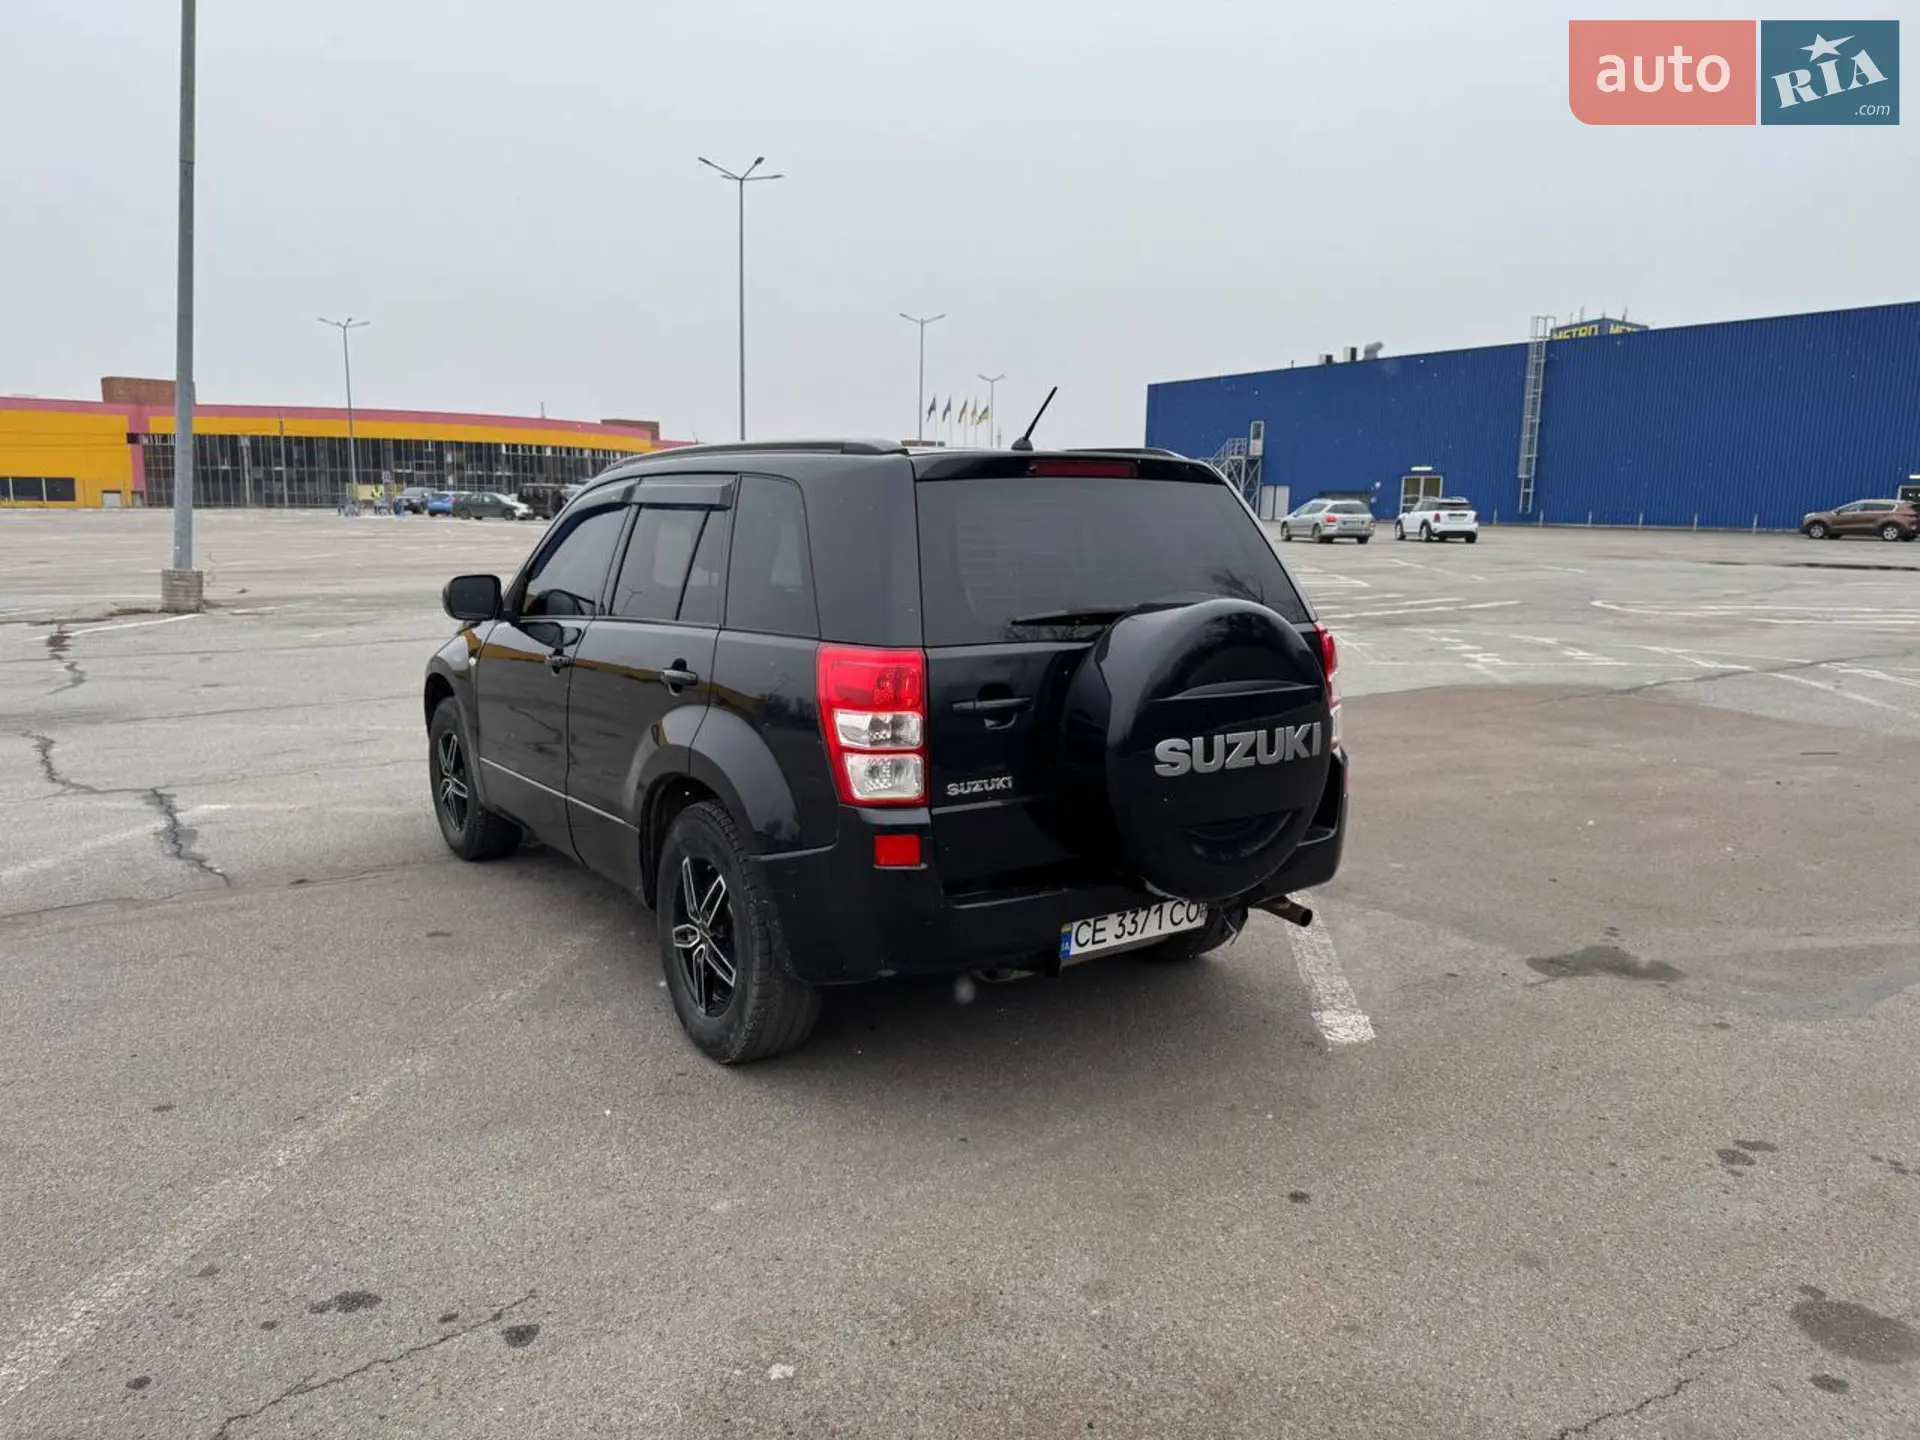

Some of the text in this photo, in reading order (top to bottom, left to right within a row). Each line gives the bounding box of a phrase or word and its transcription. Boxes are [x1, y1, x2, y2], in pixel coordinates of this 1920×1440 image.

[1154, 721, 1322, 777] SUZUKI
[947, 776, 1012, 796] SUZUKI
[1074, 899, 1202, 948] CE 3371 CO
